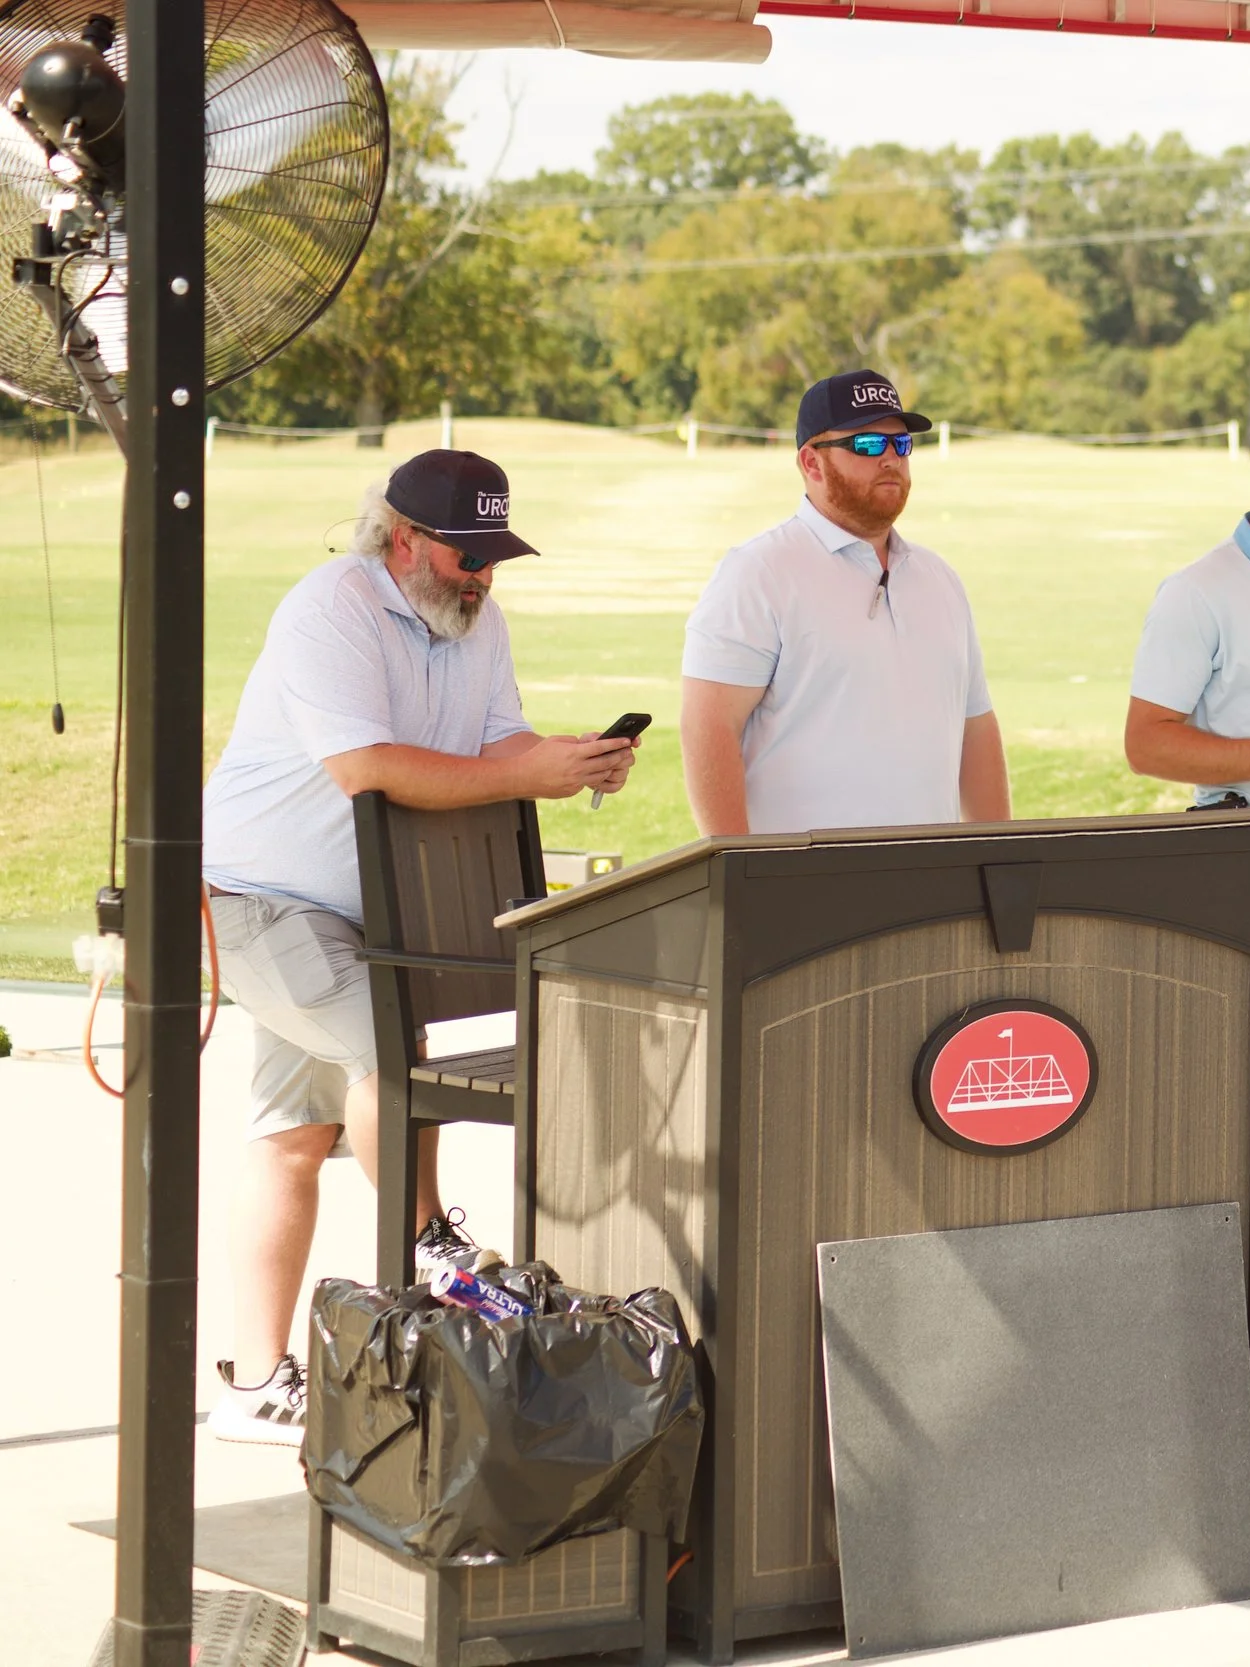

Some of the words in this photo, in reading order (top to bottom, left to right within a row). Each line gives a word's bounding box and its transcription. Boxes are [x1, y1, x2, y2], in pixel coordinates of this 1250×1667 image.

[854, 387, 897, 404] URCC
[477, 497, 509, 516] URC
[478, 1280, 524, 1316] ULTRA
